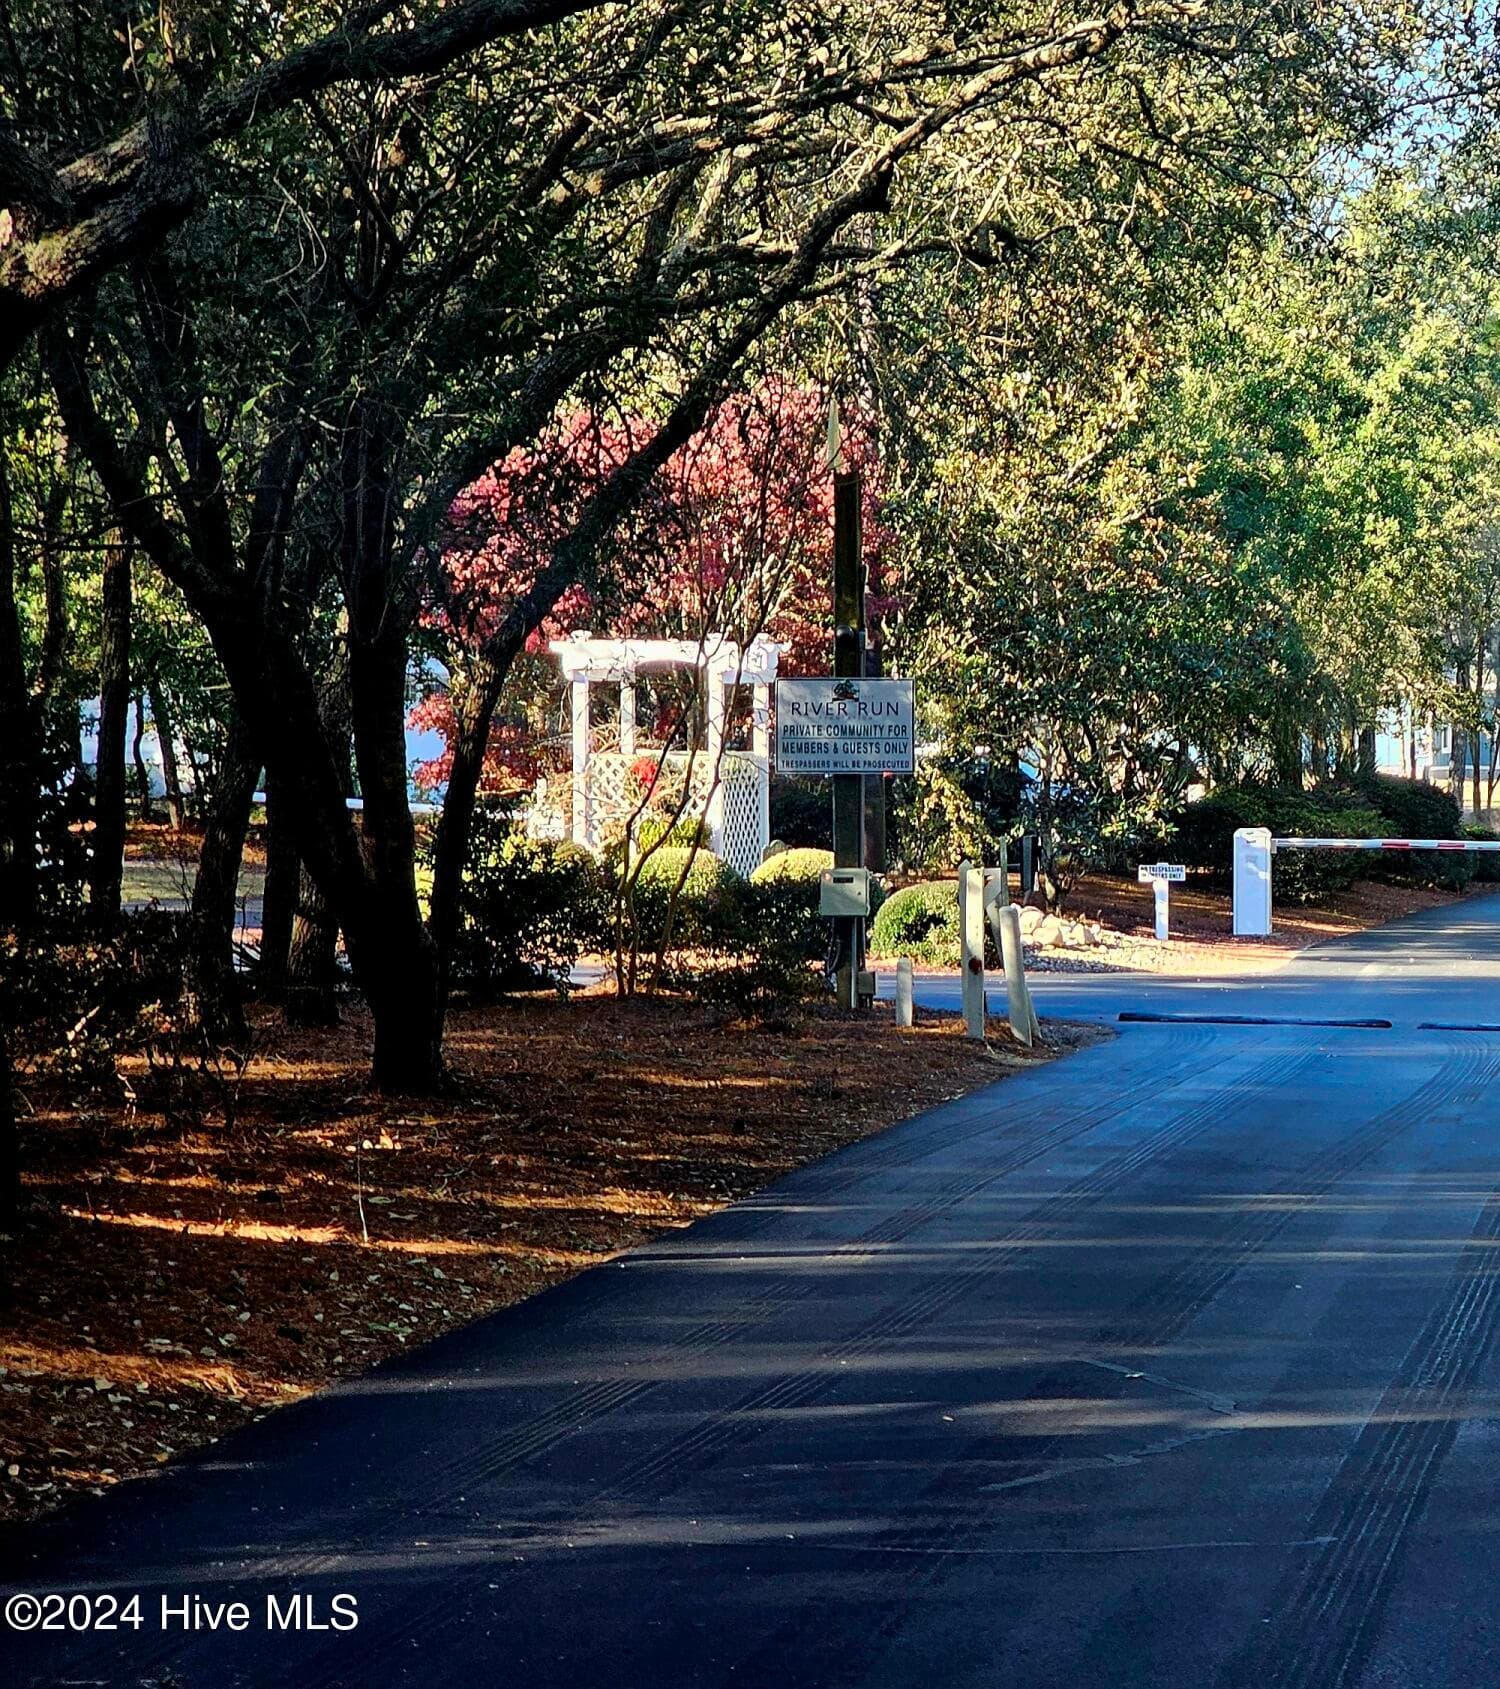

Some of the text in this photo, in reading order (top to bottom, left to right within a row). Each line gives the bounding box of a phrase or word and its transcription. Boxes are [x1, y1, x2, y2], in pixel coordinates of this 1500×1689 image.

[791, 702, 899, 716] RIVER RUN
[783, 725, 907, 737] PRIVATE COMMUNITY FOR
[782, 742, 908, 754] MEMBERS & GUESTS ONLY
[781, 760, 909, 769] TRESPASSERS WILL BE PROSECUTED
